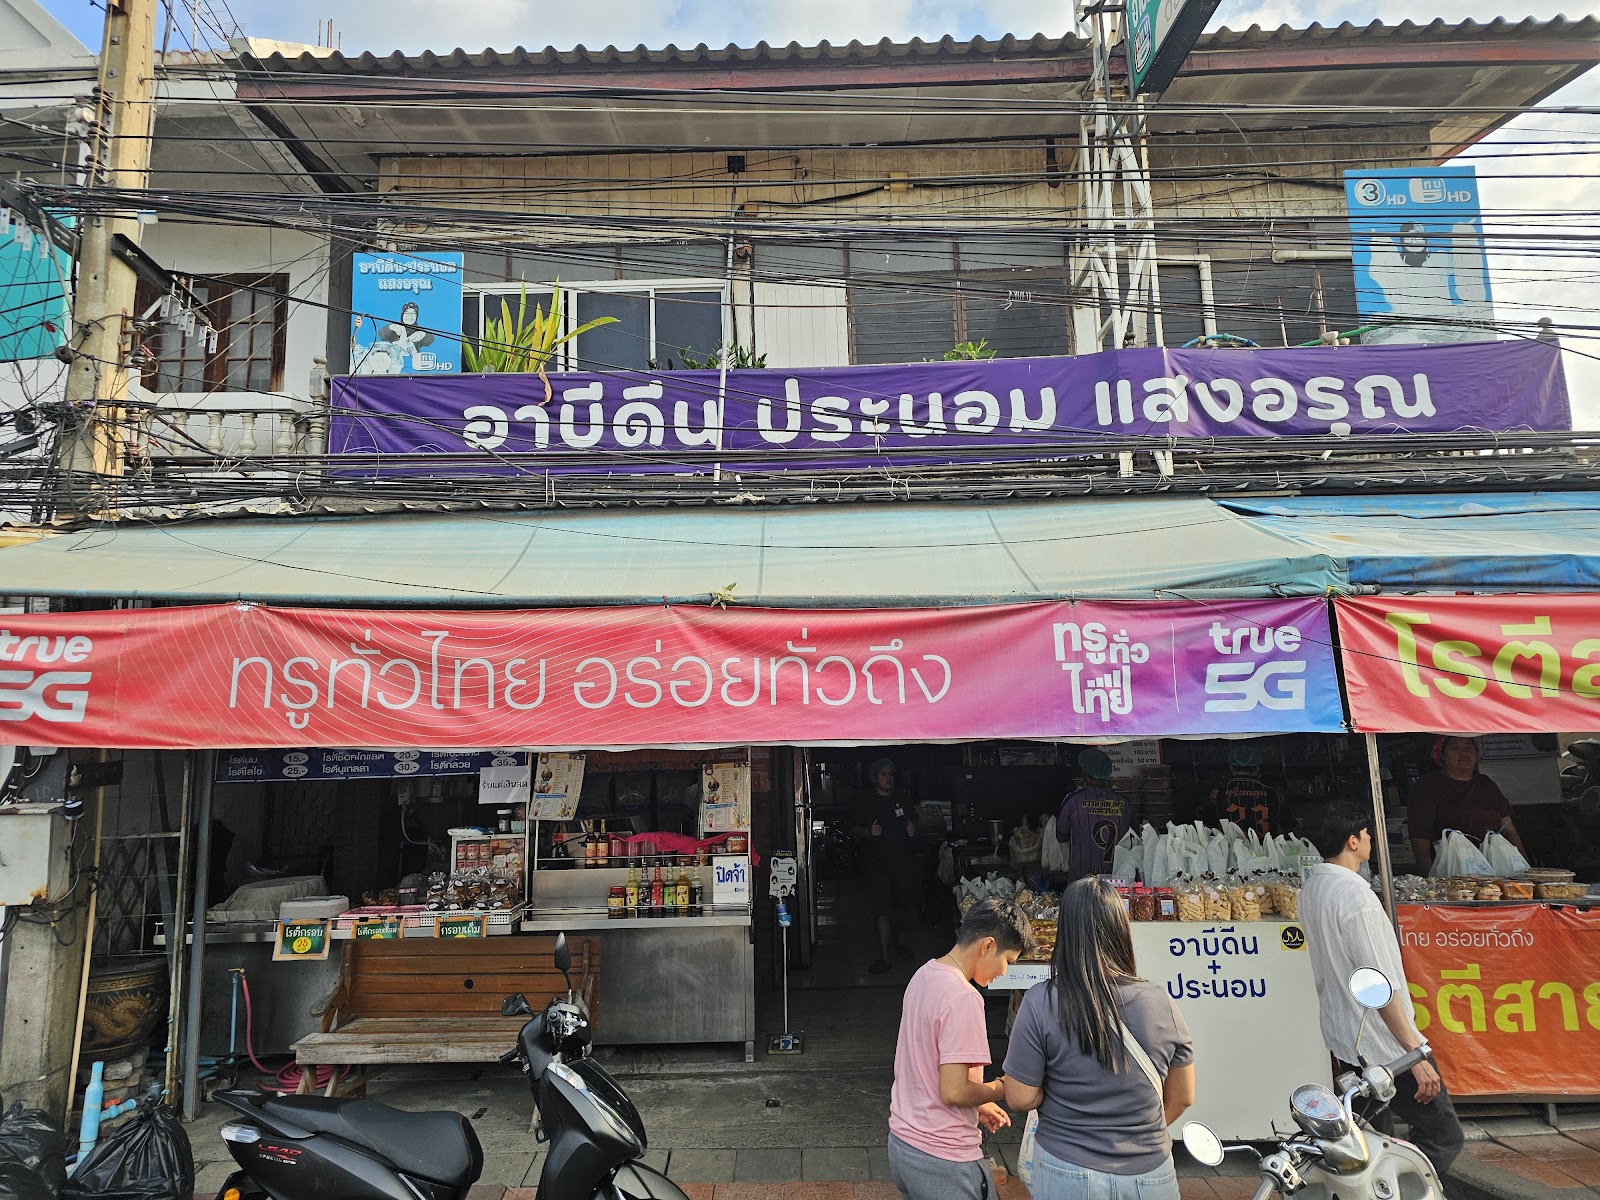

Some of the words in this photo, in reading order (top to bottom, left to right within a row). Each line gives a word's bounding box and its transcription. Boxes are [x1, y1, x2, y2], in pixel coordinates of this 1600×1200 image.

[1361, 183, 1380, 202] 3
[1387, 194, 1407, 206] HD
[1448, 191, 1472, 203] HD
[378, 278, 433, 294] แสงอรุณ
[436, 362, 453, 371] HD
[463, 379, 719, 450] อาบีดีน
[757, 378, 1058, 443] ประนอม
[1095, 373, 1437, 436] แสงอรุณ
[0, 635, 93, 662] true
[1208, 622, 1302, 654] true
[229, 629, 547, 729] ทรูทั่วไทย
[573, 628, 952, 709] อร่อยทั่วถึง
[1205, 660, 1306, 712] 5G
[1092, 819, 1118, 864] 9
[716, 863, 745, 883] ปิดจ้า
[285, 926, 324, 938] โรตีกรอบ
[1169, 926, 1259, 957] อาบีดีน
[1435, 925, 1534, 947] อร่อยทั่วถึง
[1167, 972, 1267, 1000] ประนอม
